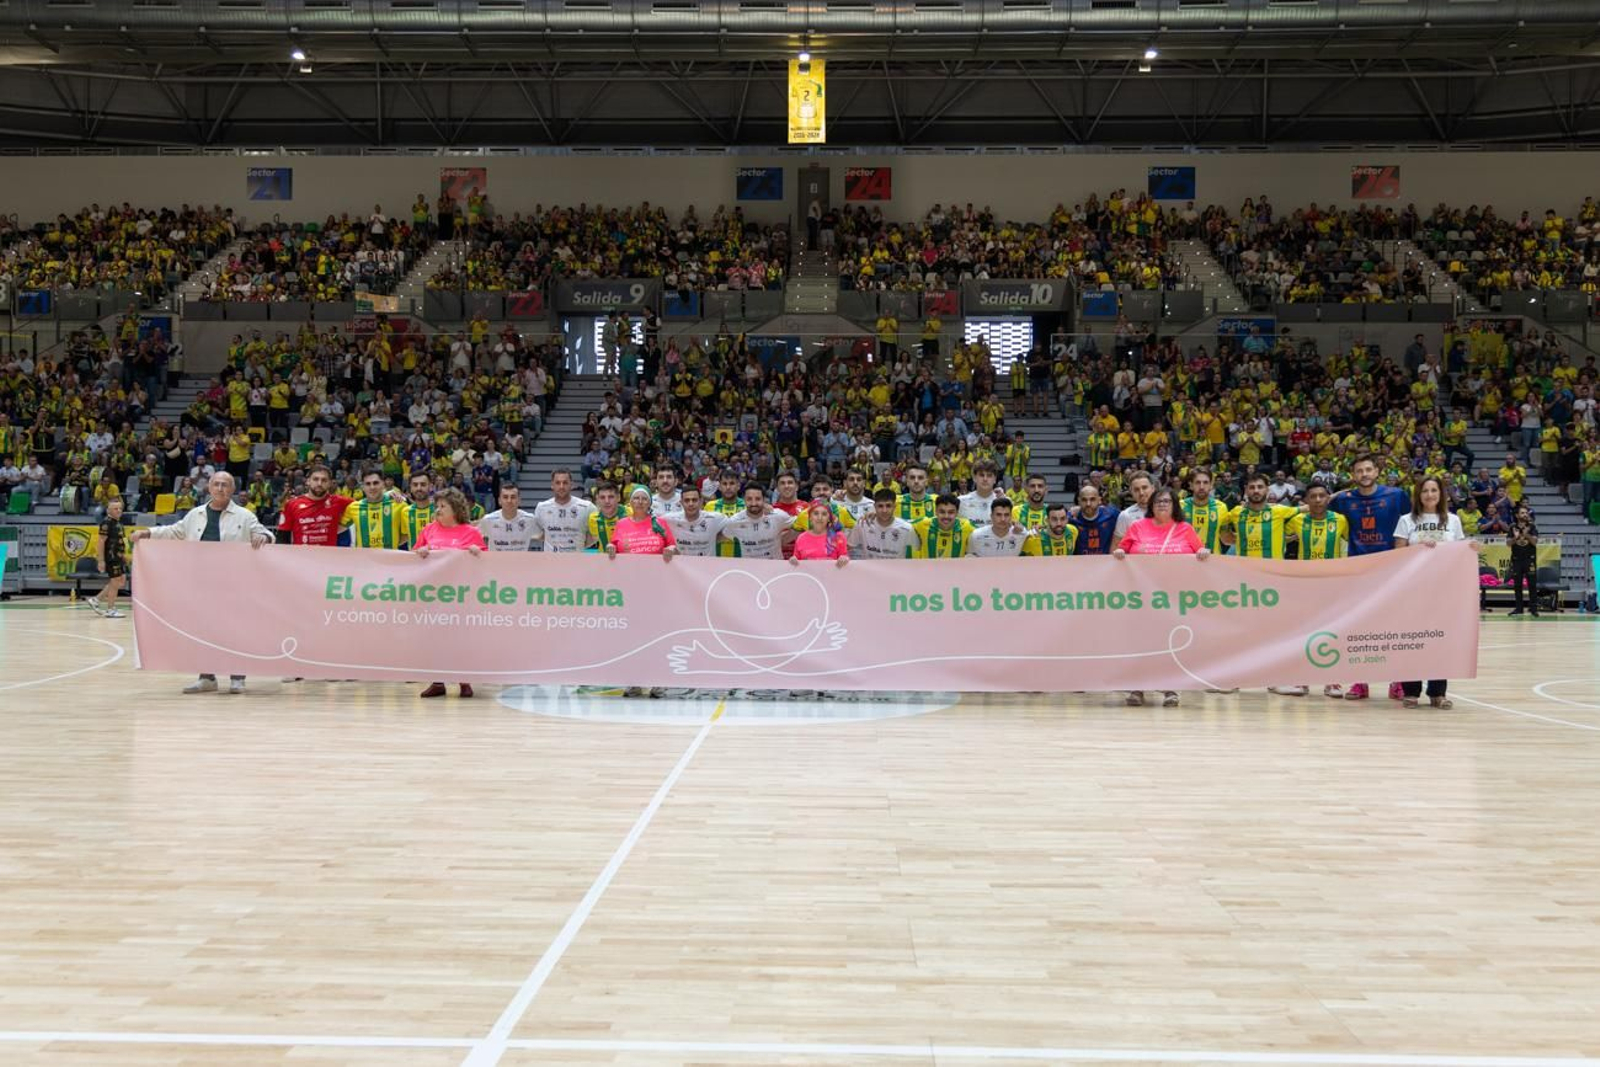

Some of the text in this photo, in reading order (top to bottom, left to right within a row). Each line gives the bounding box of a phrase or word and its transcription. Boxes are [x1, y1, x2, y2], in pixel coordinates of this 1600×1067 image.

[803, 90, 811, 101] 2
[247, 168, 276, 177] Sector
[440, 167, 470, 177] Sector
[735, 168, 767, 177] Sector
[845, 168, 876, 177] Sector
[1148, 168, 1179, 177] Sector
[1352, 167, 1383, 176] Sector
[848, 168, 890, 199] 24
[572, 283, 645, 305] Salida 9
[980, 283, 1053, 305] Salida 10
[1053, 343, 1078, 362] 24
[1315, 528, 1324, 536] 17
[325, 576, 625, 607] El cáncer de mama
[889, 583, 1280, 616] nos lo tomamos a pecho
[324, 609, 333, 625] y
[392, 608, 409, 623] lo
[413, 609, 460, 625] viven
[466, 611, 513, 627] miles
[518, 612, 542, 627] de
[546, 615, 629, 631] personas
[1347, 629, 1445, 642] asociación española
[1347, 644, 1379, 653] contra
[1381, 642, 1391, 652] el
[1349, 655, 1361, 664] en
